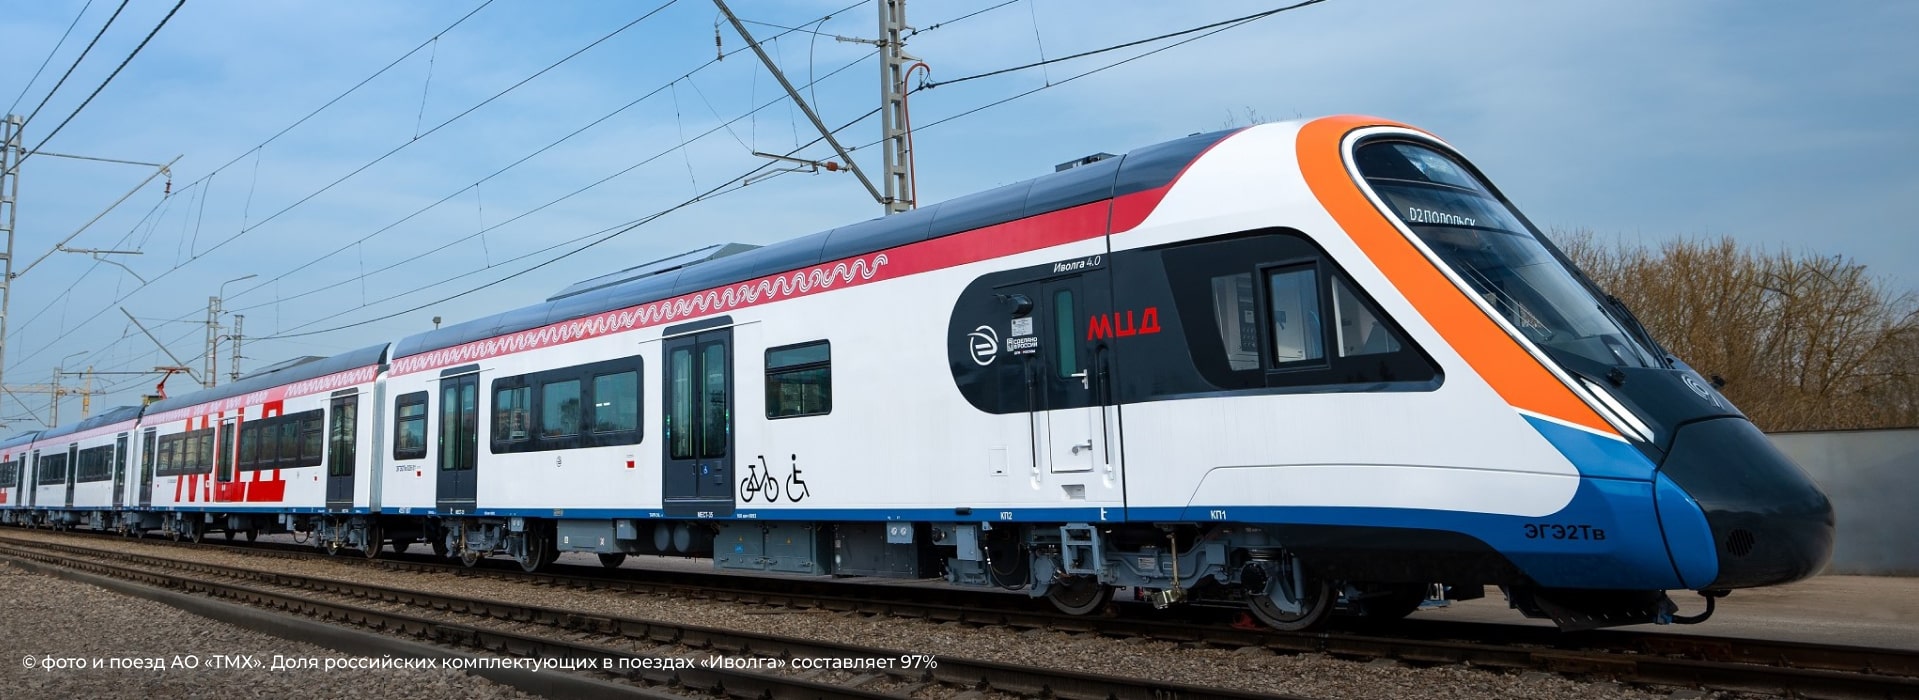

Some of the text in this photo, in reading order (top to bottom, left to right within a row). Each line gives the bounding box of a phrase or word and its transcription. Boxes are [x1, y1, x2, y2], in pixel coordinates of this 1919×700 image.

[1053, 255, 1101, 273] Иволга 4.0
[1087, 307, 1161, 341] МЦД
[1000, 511, 1013, 520] КП2
[1210, 510, 1227, 520] КП1
[1524, 523, 1606, 541] ЭГЭ2Тв
